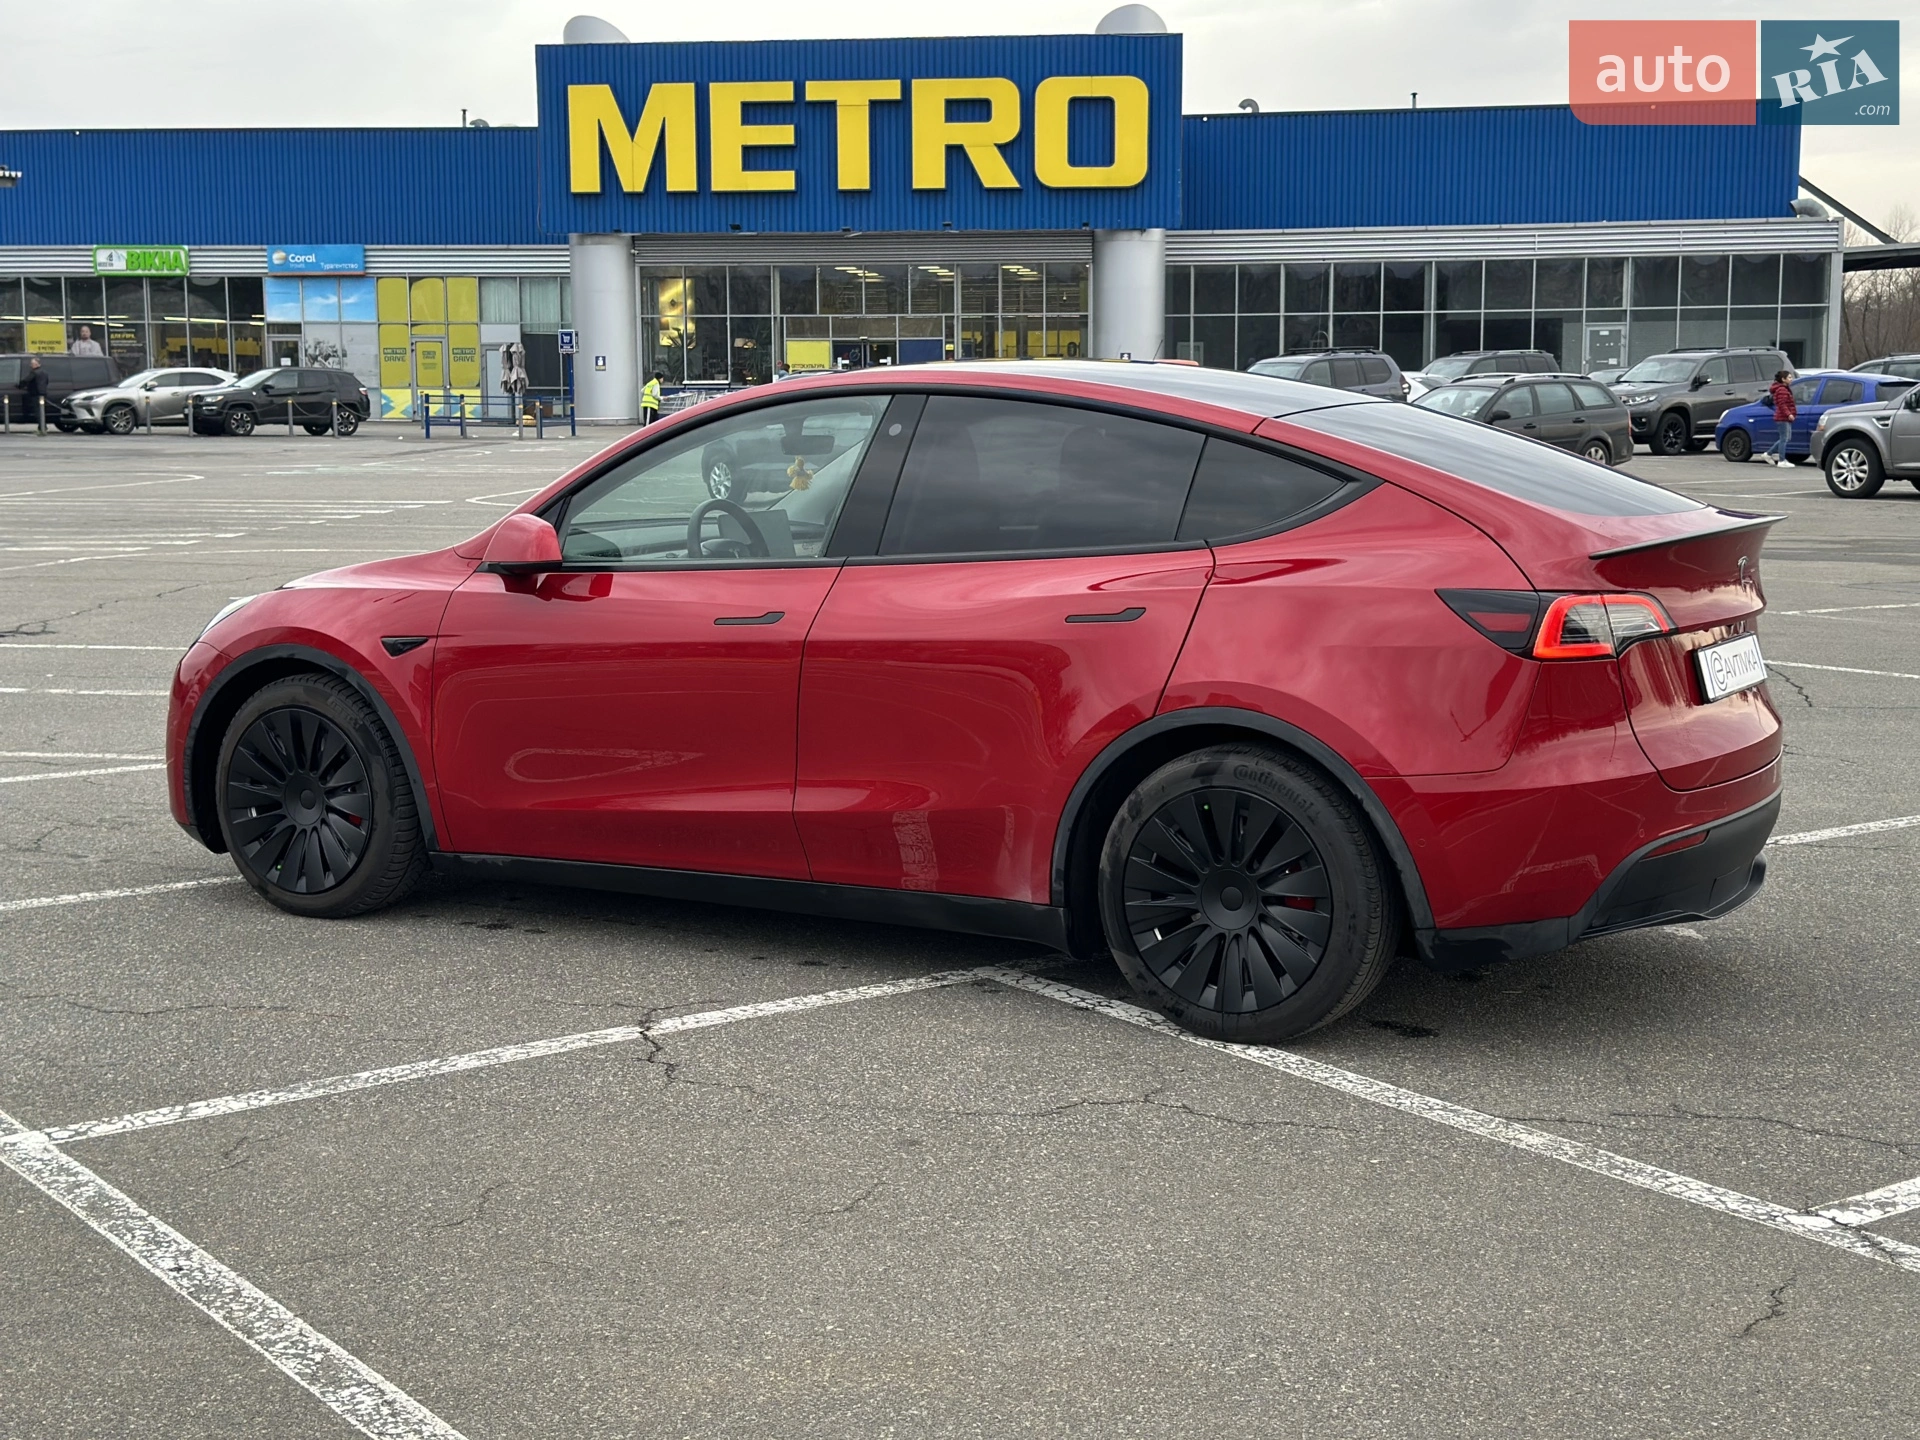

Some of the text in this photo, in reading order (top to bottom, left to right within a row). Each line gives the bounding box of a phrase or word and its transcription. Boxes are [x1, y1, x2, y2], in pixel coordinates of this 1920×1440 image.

[567, 75, 1150, 194] METRO
[126, 250, 185, 271] ВІКНА
[288, 253, 316, 263] Coral
[320, 262, 358, 270] Турагентство
